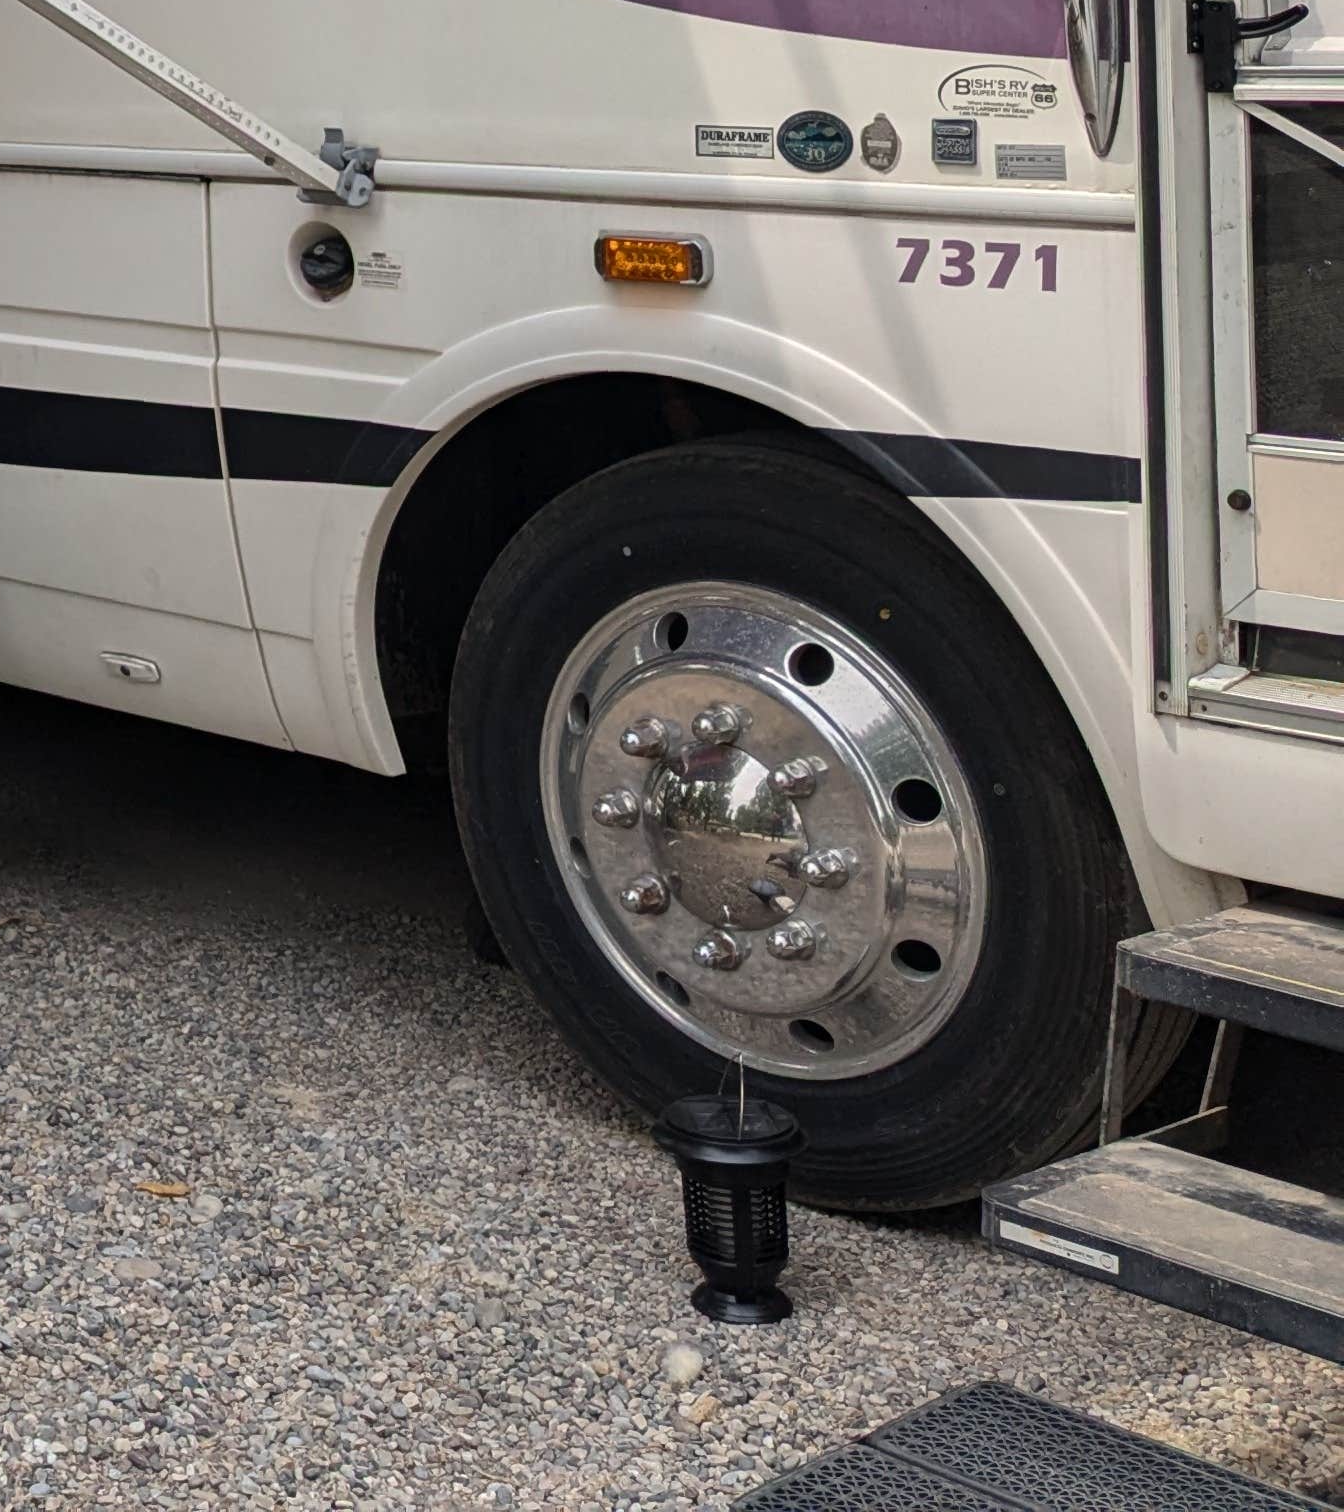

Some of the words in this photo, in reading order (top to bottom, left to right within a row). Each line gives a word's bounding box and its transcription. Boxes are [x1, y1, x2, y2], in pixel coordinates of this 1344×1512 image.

[954, 78, 1006, 95] BISH'S
[1009, 80, 1029, 90] RV
[998, 90, 1028, 98] CENTER
[1034, 93, 1053, 103] 66
[701, 130, 770, 143] DURAFRAME
[896, 238, 1058, 292] 7371
